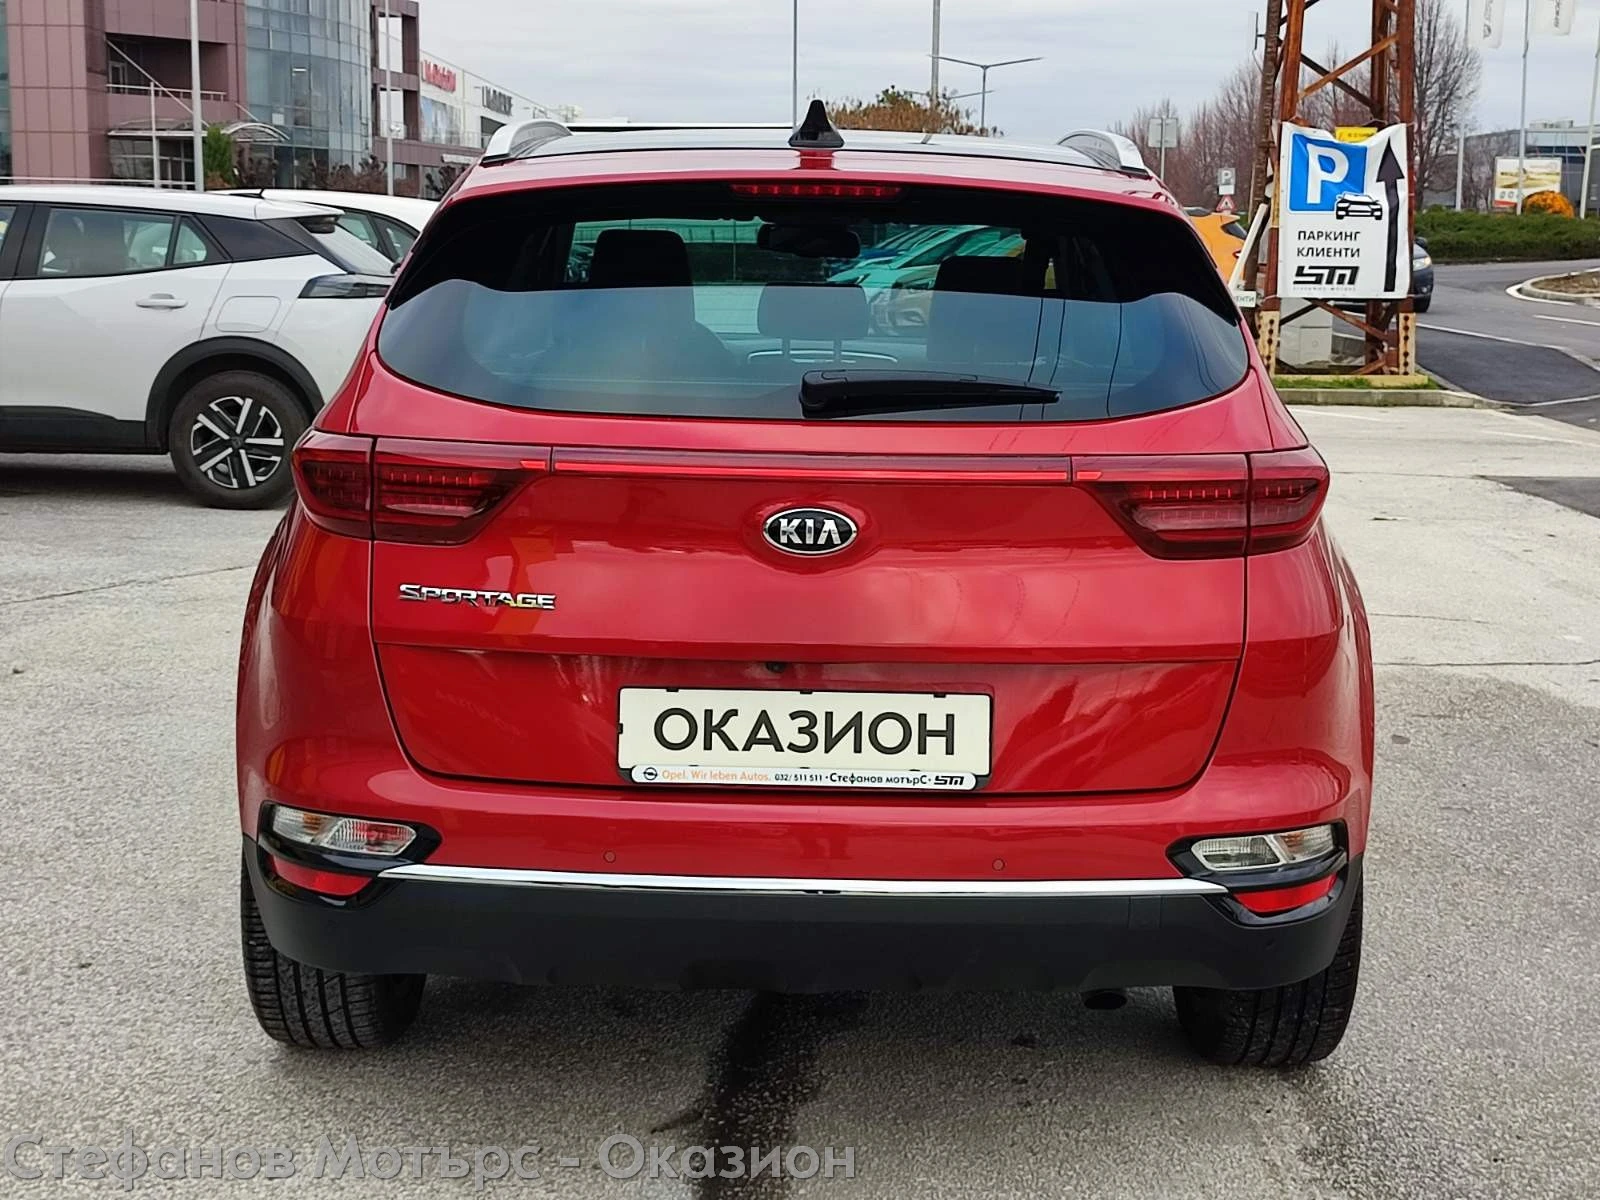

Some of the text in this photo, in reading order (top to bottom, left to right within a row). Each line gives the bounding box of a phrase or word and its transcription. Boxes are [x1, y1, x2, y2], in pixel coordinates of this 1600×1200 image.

[1306, 142, 1350, 204] P
[1297, 230, 1361, 241] ПАРКИНГ
[1297, 246, 1360, 258] КЛИЕНТИ
[779, 518, 842, 545] KIA
[399, 584, 556, 609] SPORTAGE
[653, 707, 955, 755] ОКАЗИОН
[690, 770, 707, 781] Wir
[710, 770, 737, 781] leben
[794, 773, 807, 783] 511
[809, 773, 822, 783] 511
